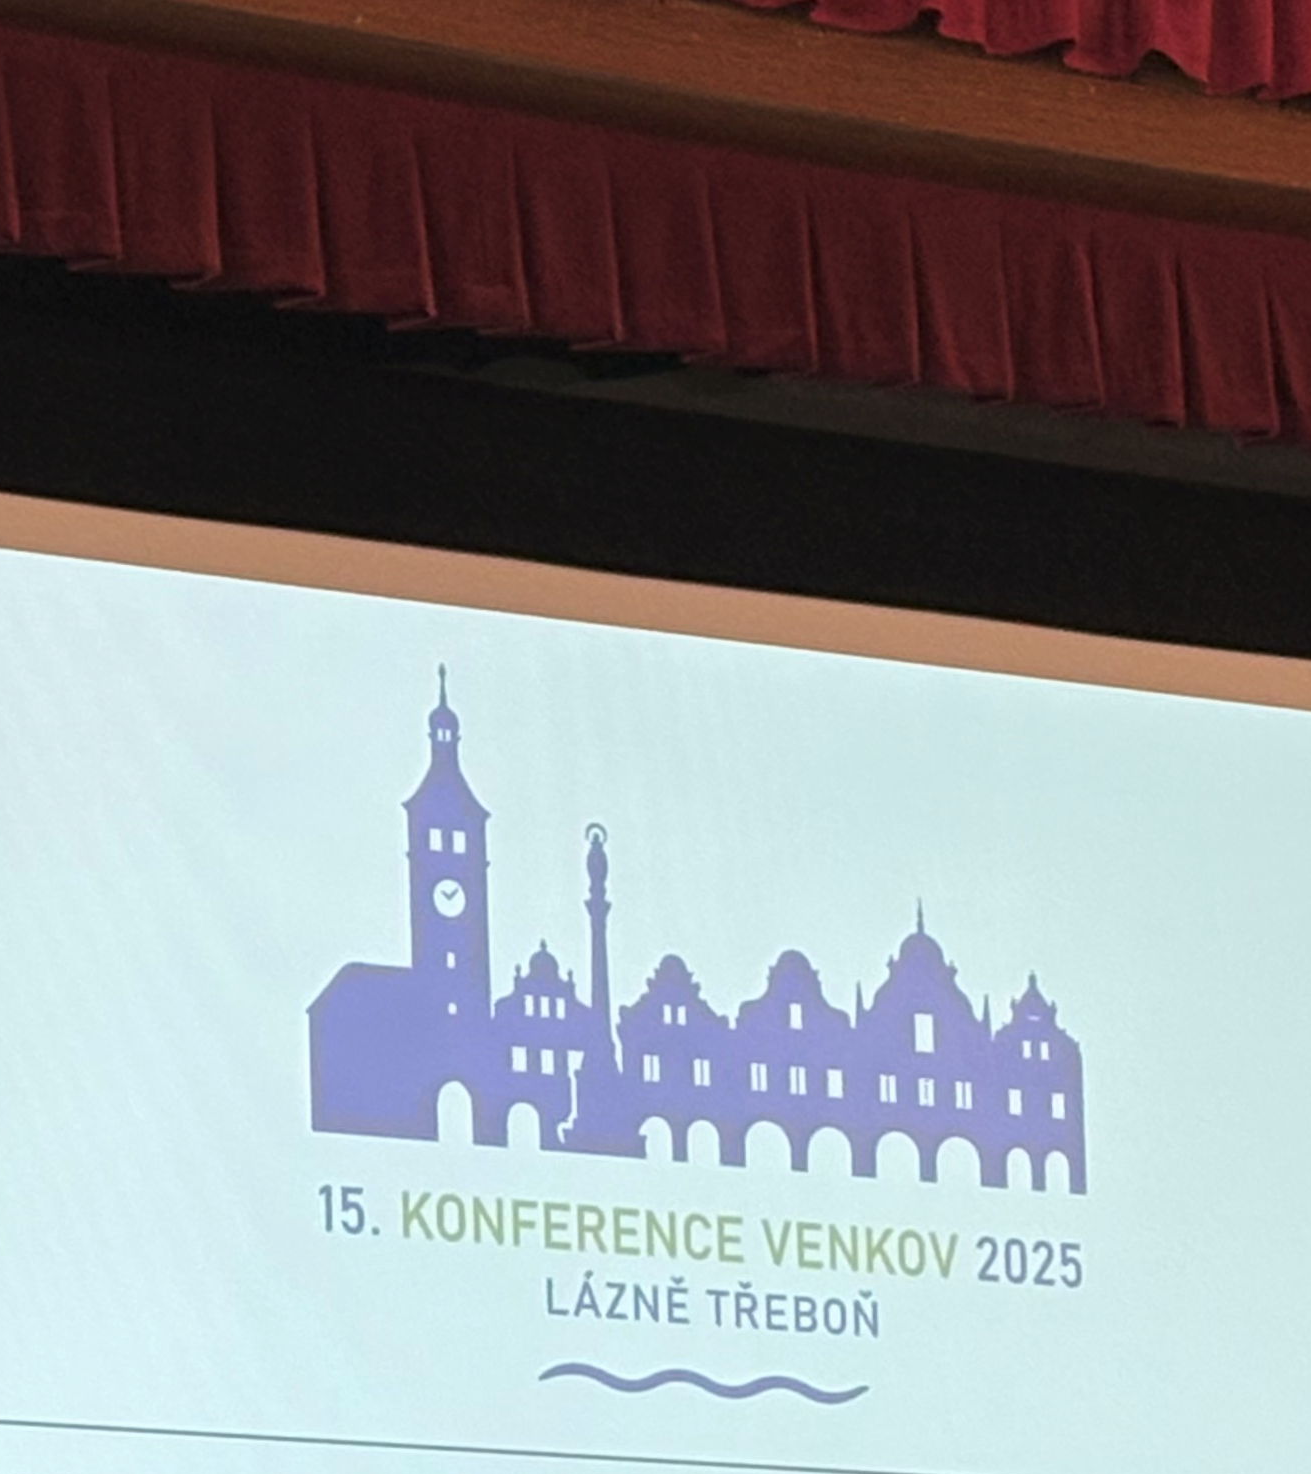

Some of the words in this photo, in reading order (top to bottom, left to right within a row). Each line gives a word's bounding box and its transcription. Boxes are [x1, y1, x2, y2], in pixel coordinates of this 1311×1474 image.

[318, 1184, 381, 1236] 15.
[401, 1189, 745, 1264] KONFERENCE
[760, 1218, 959, 1280] VENKOV
[975, 1235, 1083, 1289] 2025
[546, 1269, 691, 1325] LÁZNĚ
[705, 1281, 879, 1339] TŘEBOŇ
